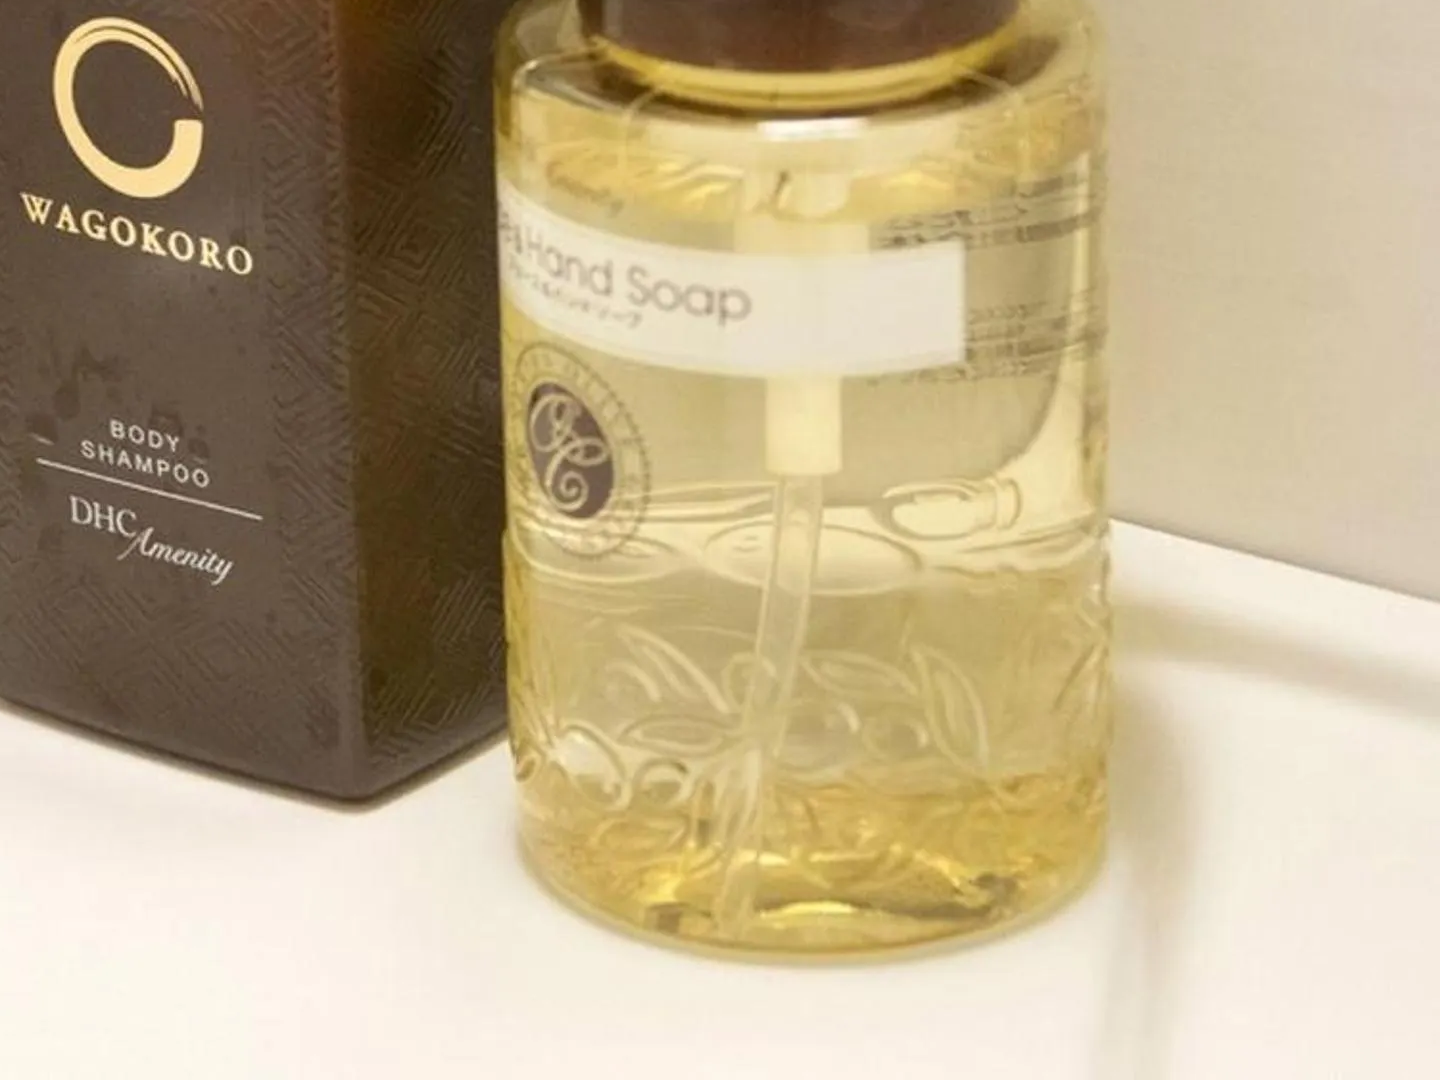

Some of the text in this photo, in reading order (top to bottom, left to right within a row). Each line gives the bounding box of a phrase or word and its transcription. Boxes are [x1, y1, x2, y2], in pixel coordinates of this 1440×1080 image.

[19, 190, 253, 275] WAGOKORO
[526, 223, 613, 297] Hand
[625, 264, 753, 328] Soap
[79, 438, 211, 488] SHAMPOO
[109, 418, 181, 453] BODY
[68, 494, 234, 586] DHC Amenity
